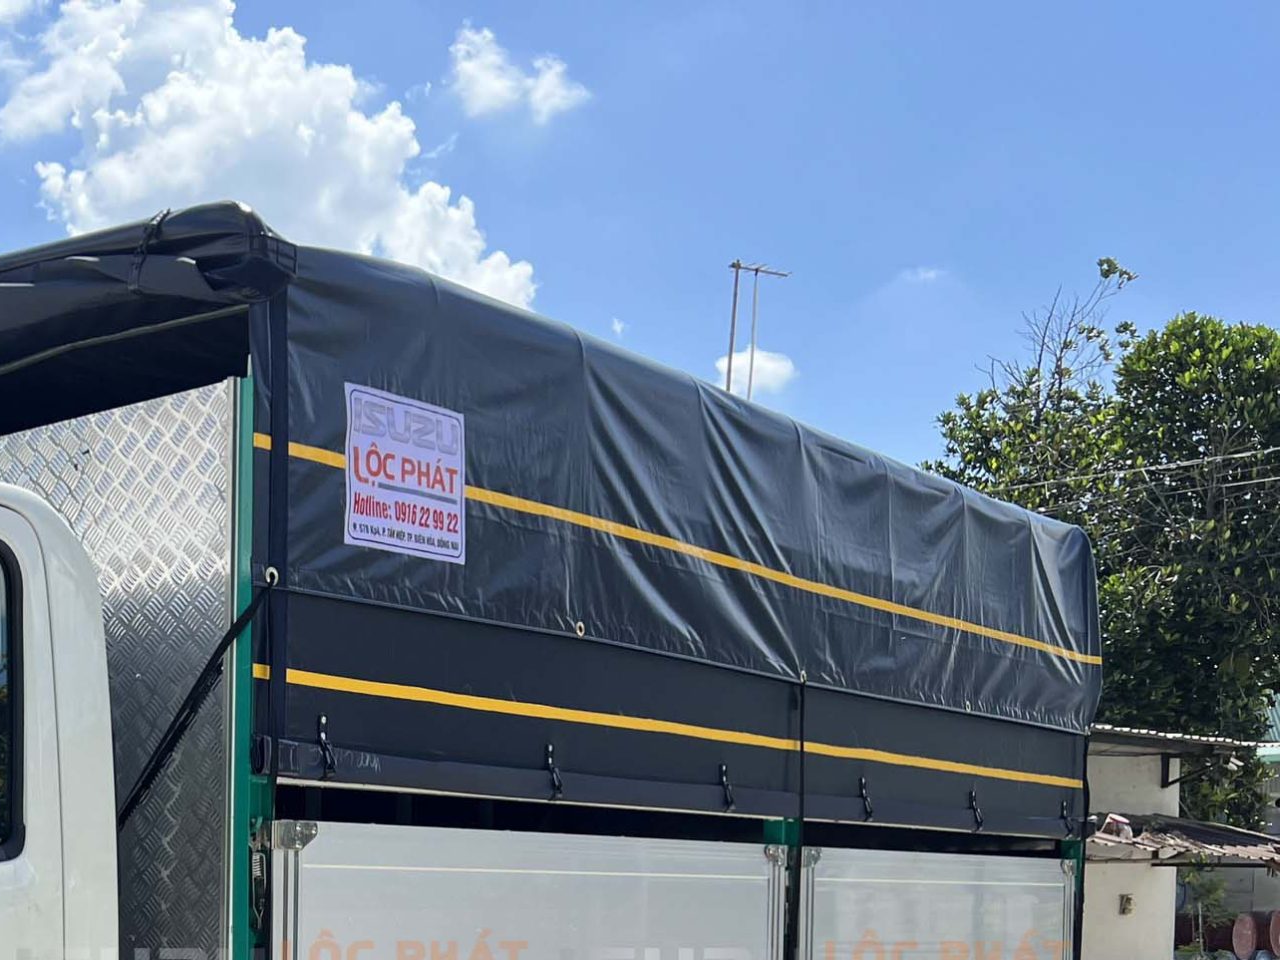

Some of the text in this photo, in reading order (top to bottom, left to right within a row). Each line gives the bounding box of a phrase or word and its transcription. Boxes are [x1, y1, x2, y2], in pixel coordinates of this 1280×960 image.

[353, 397, 459, 456] ISUZU
[353, 442, 458, 494] LỘC PHÁT
[353, 491, 459, 534] Hotline: 0916 22 99 22
